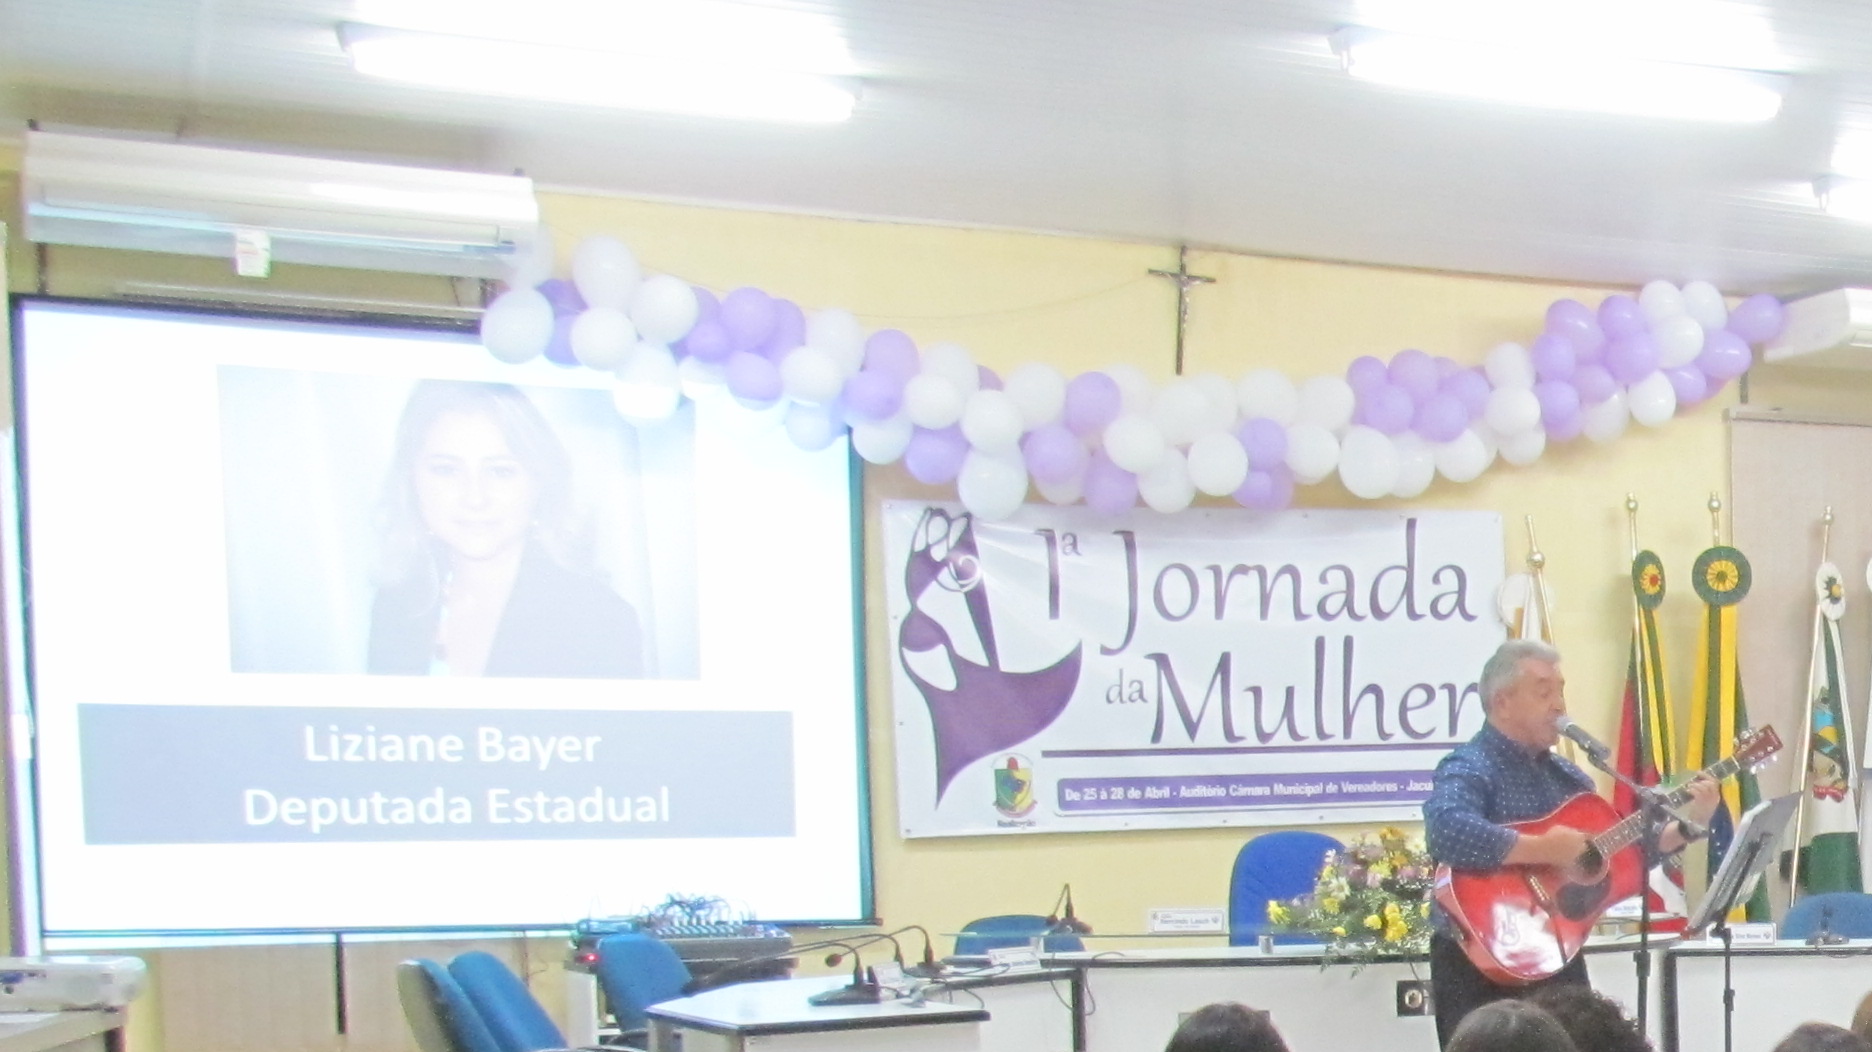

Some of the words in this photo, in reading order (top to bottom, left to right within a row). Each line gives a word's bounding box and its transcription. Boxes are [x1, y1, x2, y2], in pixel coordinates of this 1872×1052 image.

[1099, 517, 1479, 657] Jornada
[1104, 667, 1149, 705] da
[1143, 635, 1480, 746] Mulher
[304, 724, 465, 763] Liziane
[477, 727, 602, 770] Bayer
[244, 786, 473, 834] Deputada
[488, 786, 671, 825] Estadual
[1065, 788, 1081, 801] De
[1083, 787, 1097, 800] 25
[1110, 786, 1125, 800] 28
[1127, 786, 1142, 799] de
[1144, 785, 1170, 799] Abril
[1179, 784, 1227, 799] Auditório
[1273, 781, 1323, 798] Municipal
[1325, 781, 1339, 794] de
[1341, 780, 1398, 794] Vereadores
